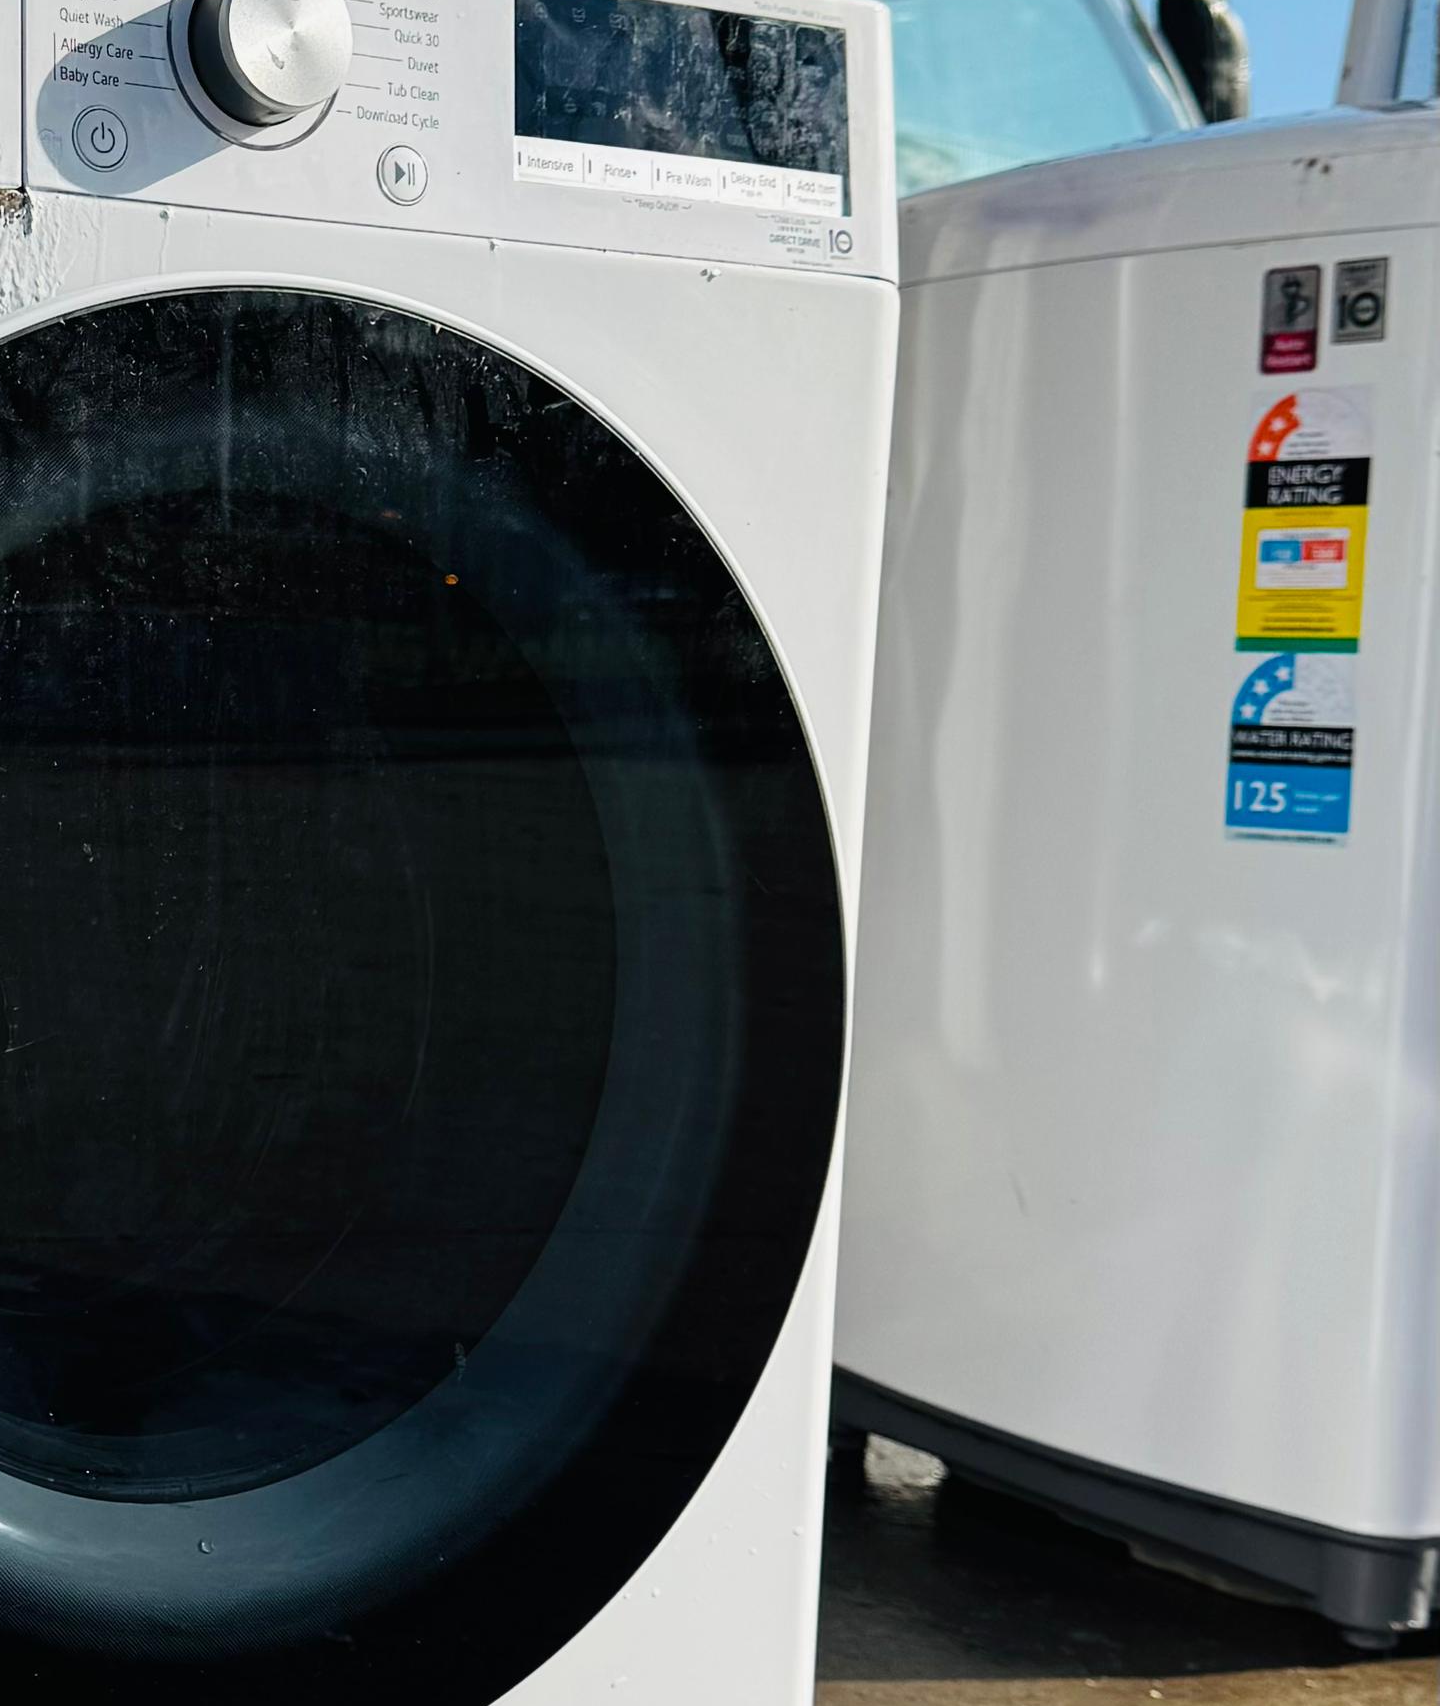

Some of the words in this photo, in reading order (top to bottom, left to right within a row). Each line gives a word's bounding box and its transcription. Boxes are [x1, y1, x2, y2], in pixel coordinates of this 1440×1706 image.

[60, 8, 89, 24] Quiet
[94, 13, 123, 28] Wash
[380, 2, 439, 23] Sportswear
[394, 29, 422, 44] Quick
[426, 33, 439, 47] 30
[61, 38, 102, 59] Allergy
[107, 44, 133, 59] Care
[408, 57, 438, 73] Duvet
[60, 66, 88, 86] Baby
[93, 71, 119, 86] Care
[388, 82, 407, 97] Tub
[410, 86, 439, 101] Clean
[357, 105, 407, 125] Download
[412, 113, 439, 131] Cycle
[528, 156, 573, 172] Intensive
[665, 171, 681, 184] Pre
[685, 173, 711, 187] Wash
[731, 172, 756, 187] Delay
[1268, 463, 1346, 485] ENERGY
[1267, 485, 1342, 504] RATING
[1234, 781, 1287, 813] 125
